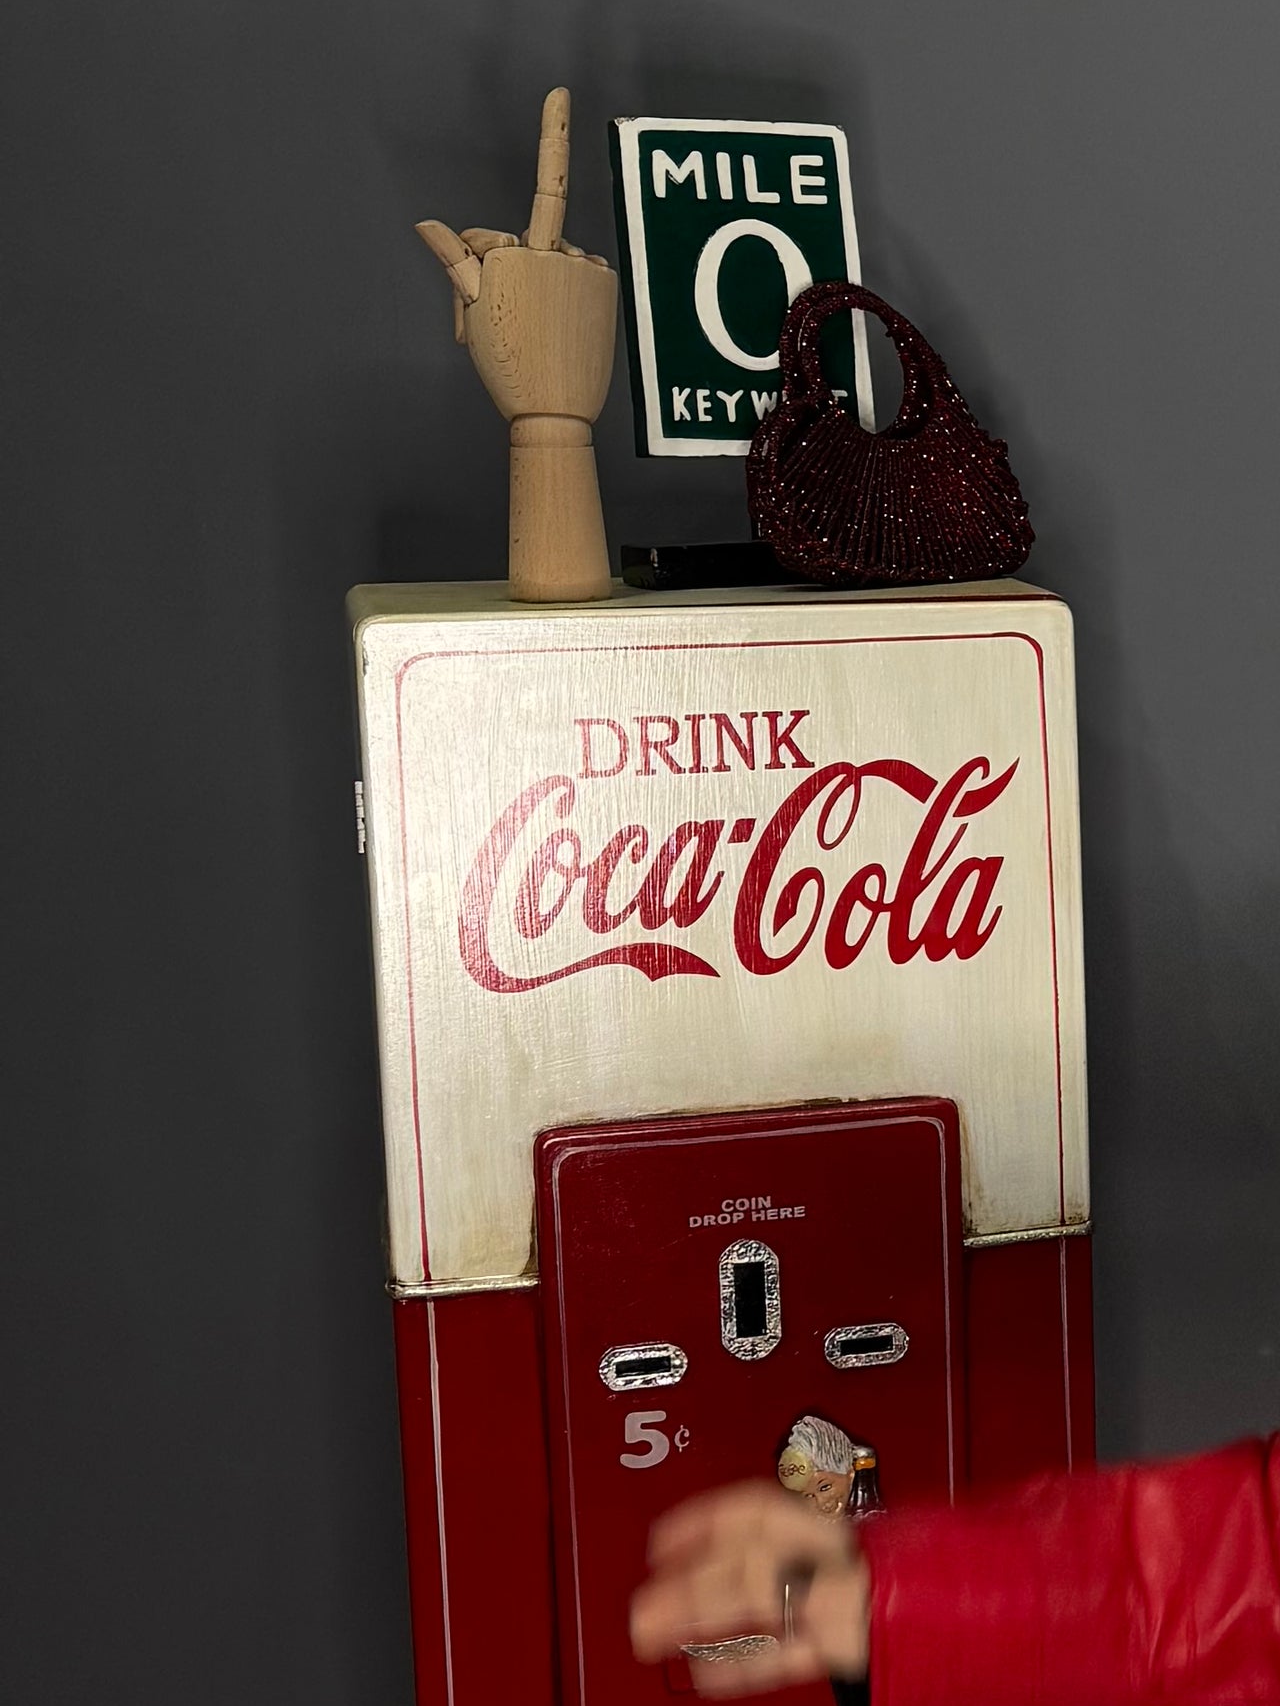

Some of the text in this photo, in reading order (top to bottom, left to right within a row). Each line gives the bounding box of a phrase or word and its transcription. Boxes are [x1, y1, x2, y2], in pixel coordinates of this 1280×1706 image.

[651, 149, 828, 205] MILE
[573, 708, 817, 779] DRINK
[688, 1204, 807, 1228] DROP HERE
[721, 1195, 772, 1213] COIN
